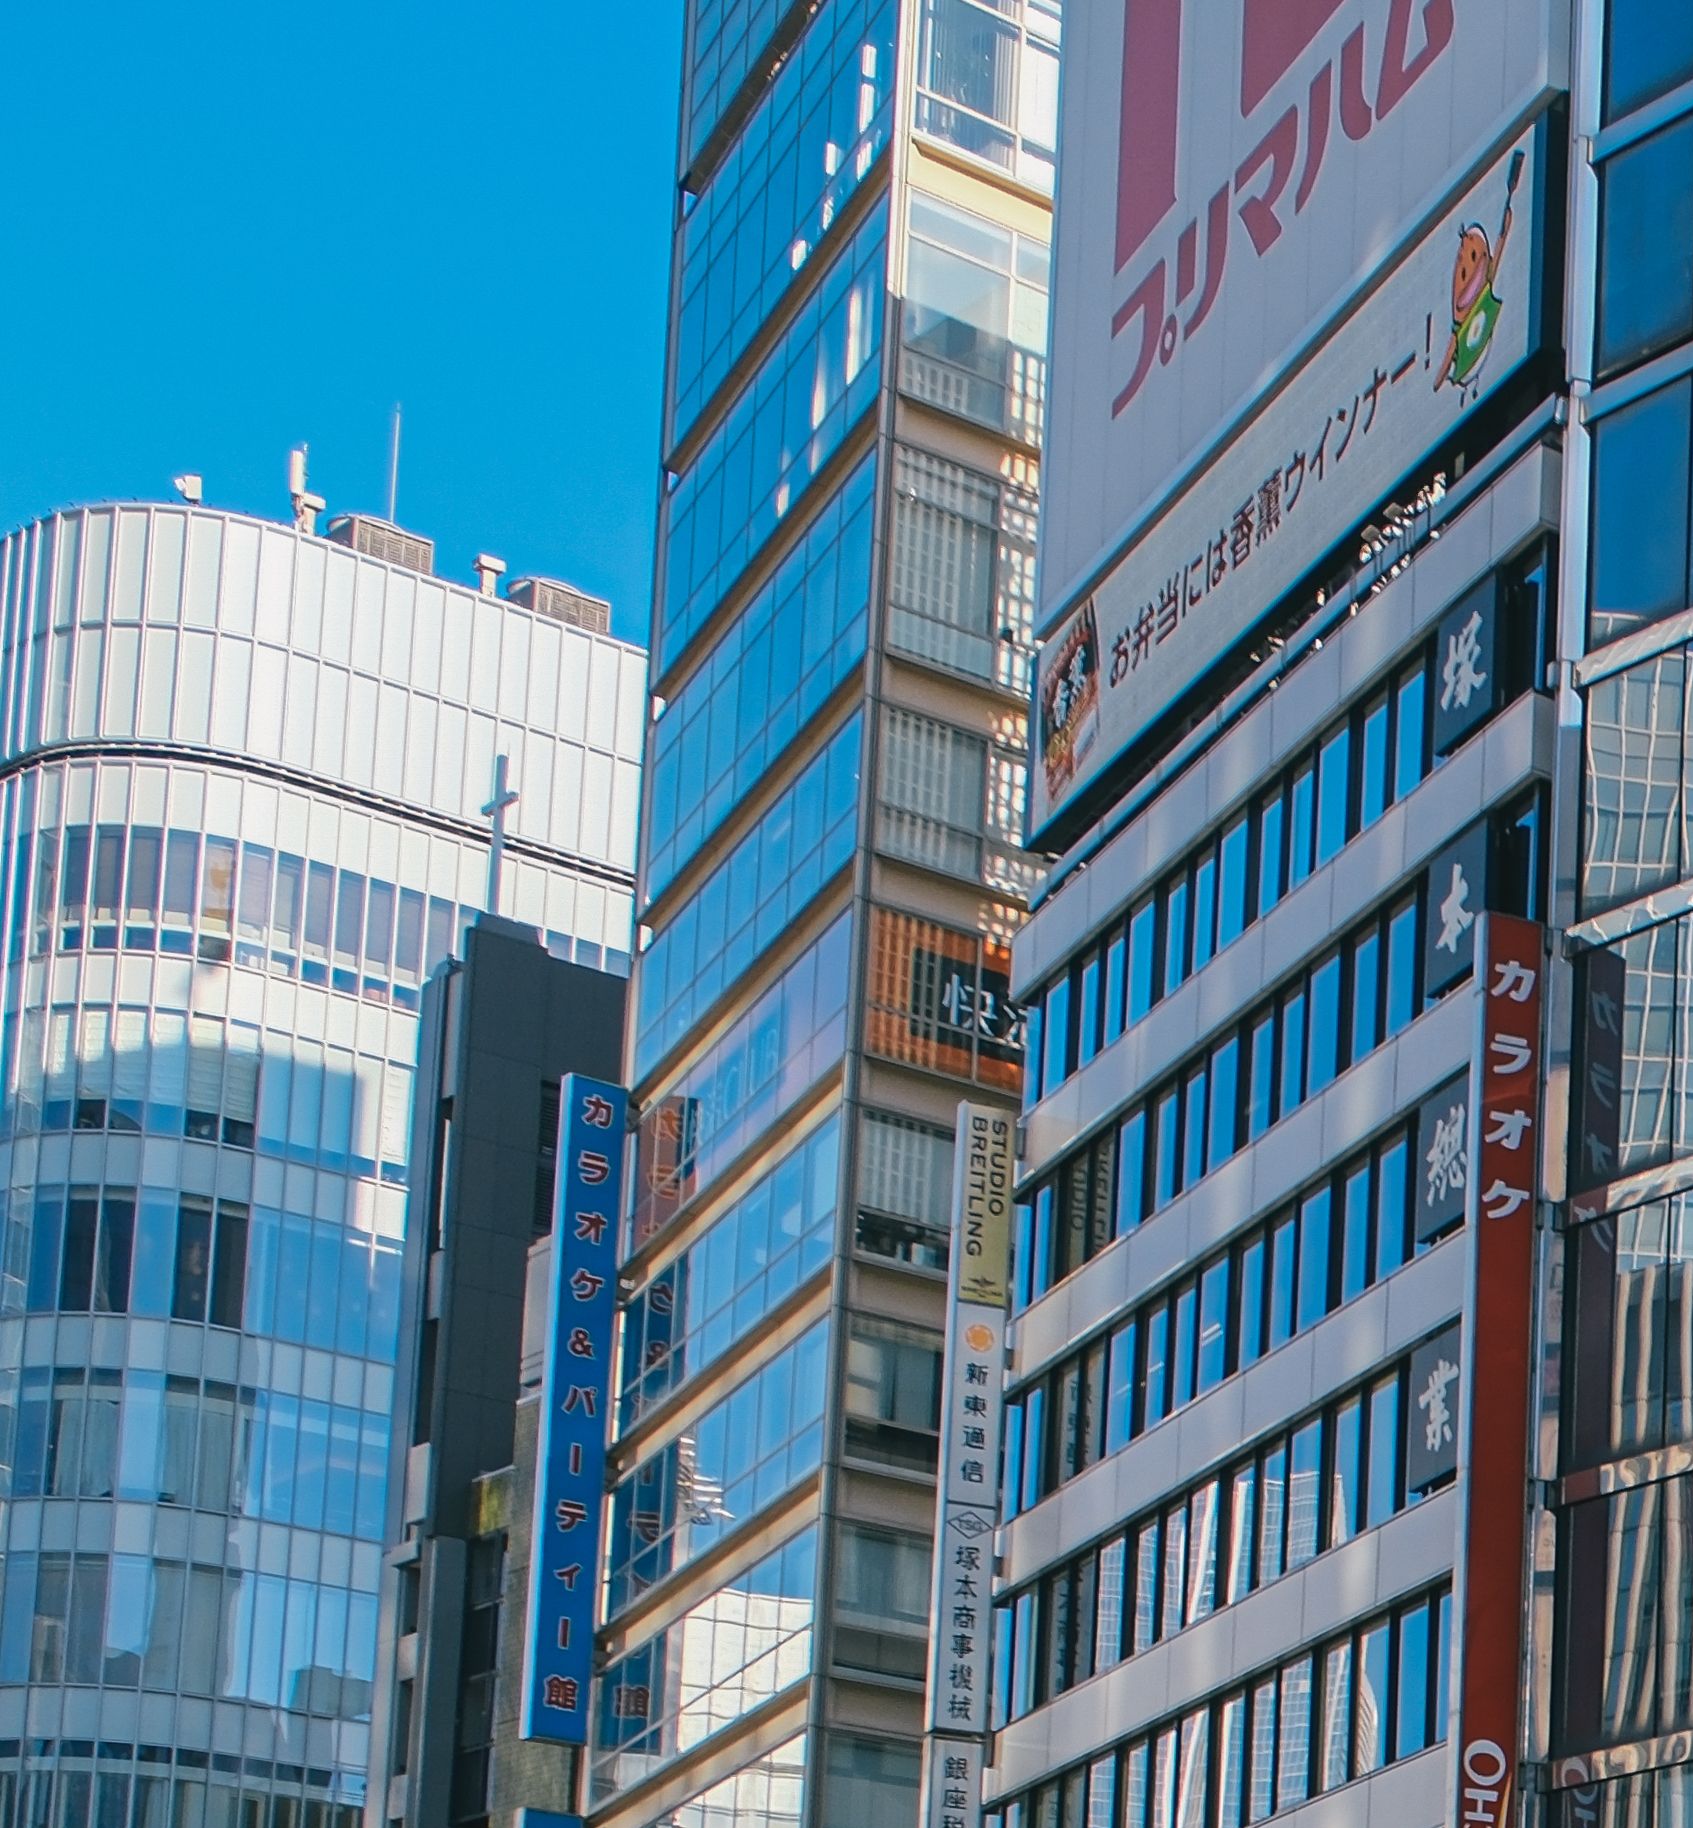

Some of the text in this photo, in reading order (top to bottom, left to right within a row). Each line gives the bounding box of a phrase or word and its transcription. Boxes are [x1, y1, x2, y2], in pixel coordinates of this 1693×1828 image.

[1110, 0, 1454, 420] プリマハム
[988, 1120, 1008, 1217] STUDIO
[1481, 960, 1537, 1220] カラオケ
[965, 1116, 990, 1258] BREITLING
[948, 1545, 982, 1722] 塚本商事機械
